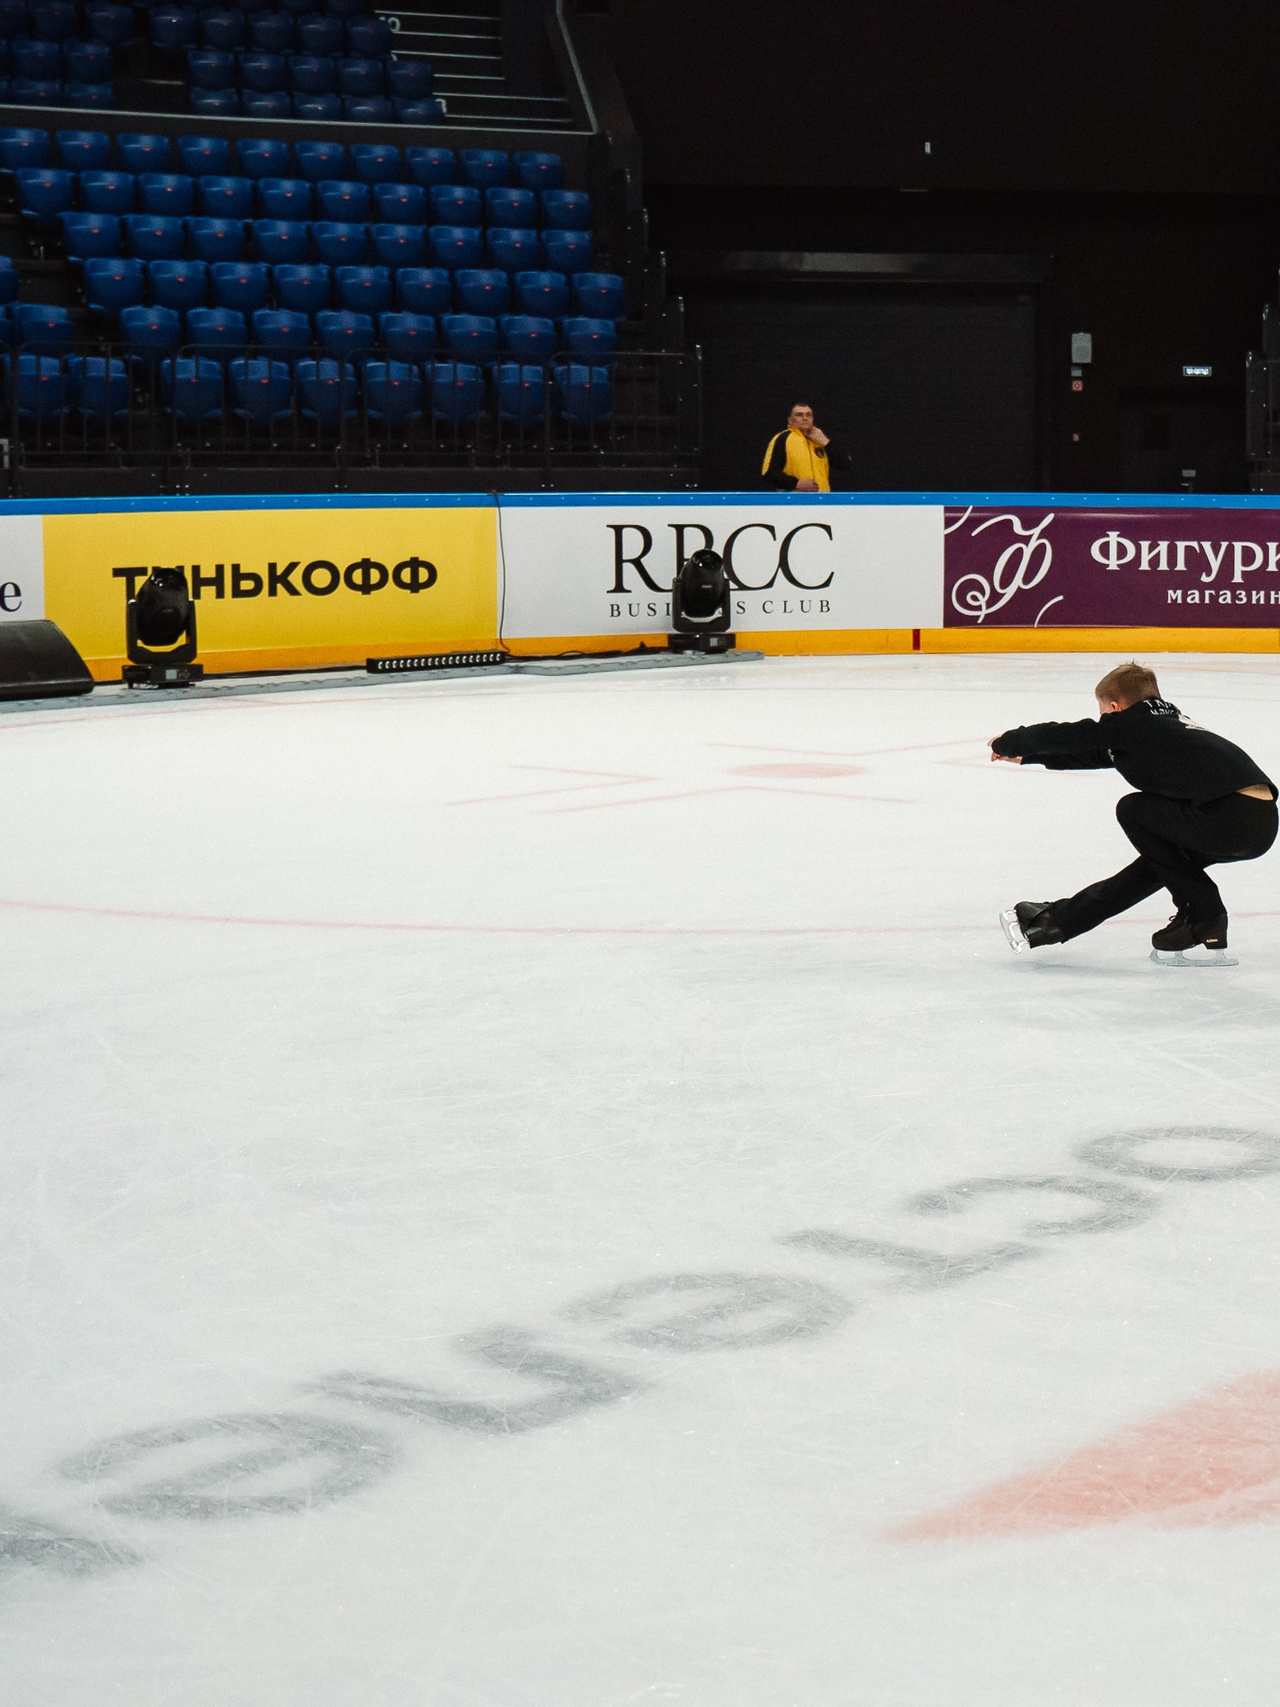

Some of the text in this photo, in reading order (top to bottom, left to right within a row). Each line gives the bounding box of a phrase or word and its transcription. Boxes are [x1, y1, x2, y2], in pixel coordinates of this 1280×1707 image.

[112, 557, 438, 600] ТНЬКОФФ
[609, 600, 831, 618] BUSIS CLUB
